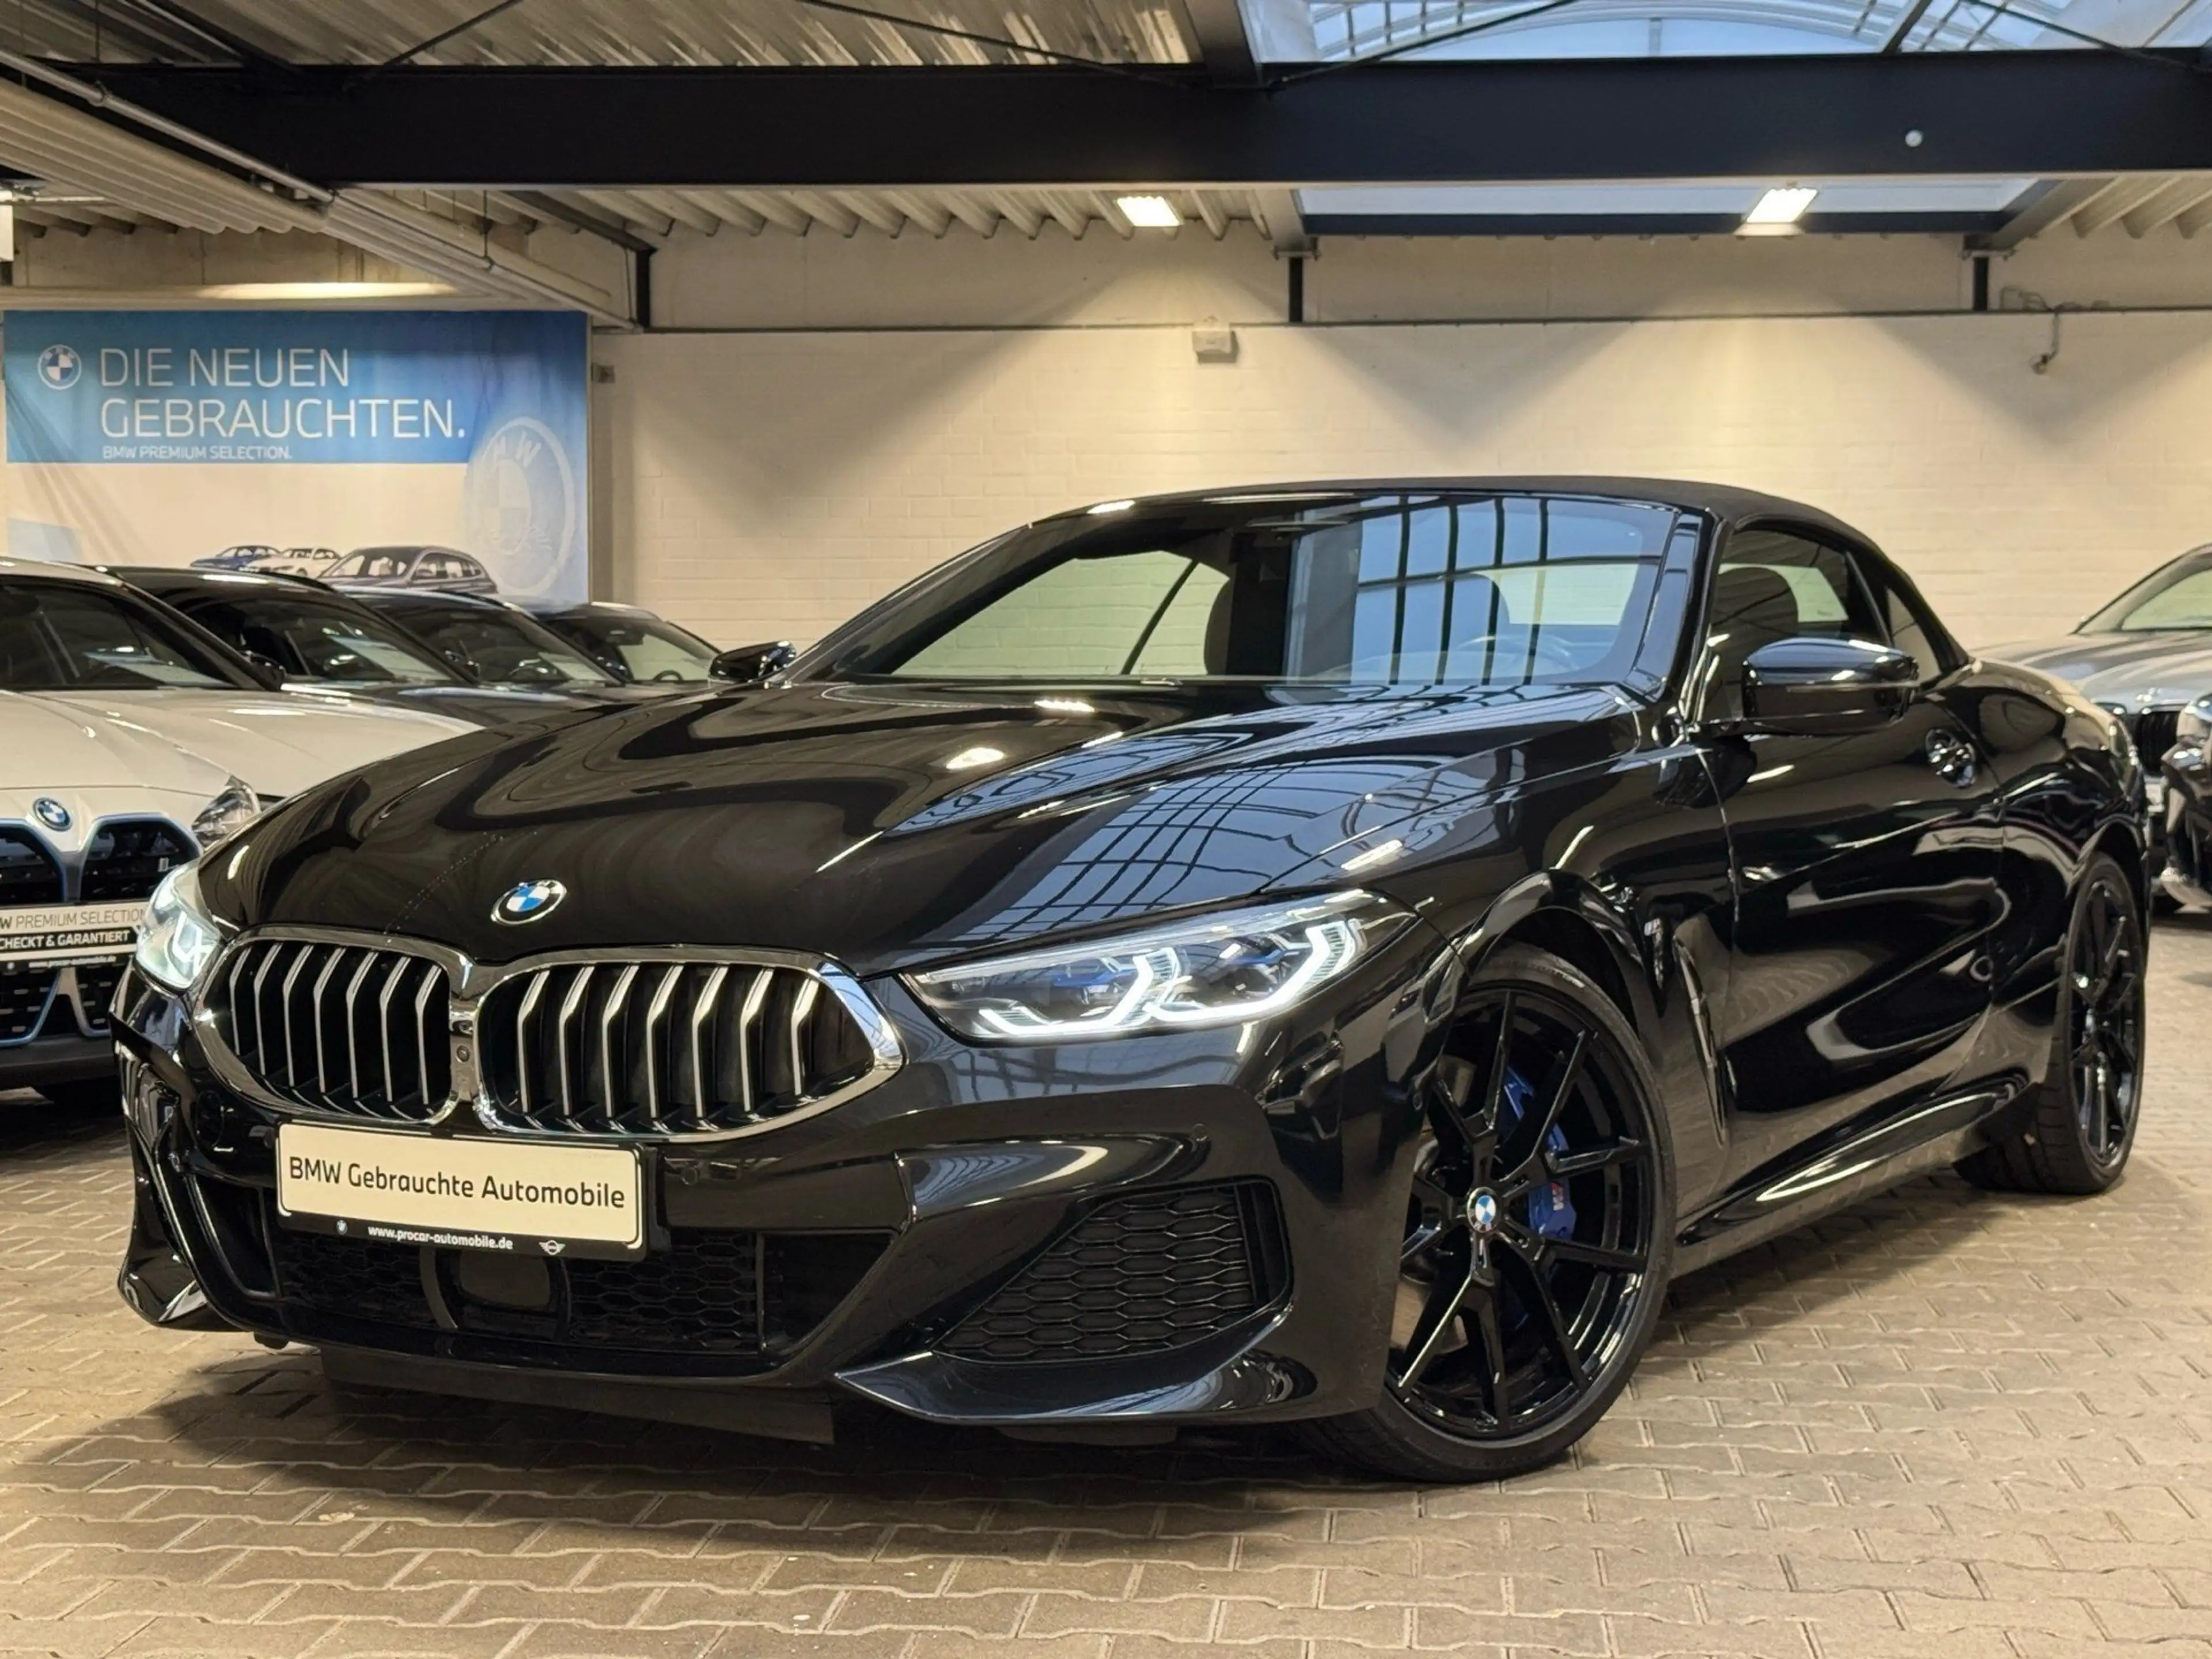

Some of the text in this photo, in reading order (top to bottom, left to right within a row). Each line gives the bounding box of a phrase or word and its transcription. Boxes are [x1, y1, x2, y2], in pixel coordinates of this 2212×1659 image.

[100, 348, 349, 388] DIE NEUEN
[101, 397, 465, 438] GEBRAUCHTEN.
[103, 445, 293, 460] BMW PREMIUM SELECTION.
[16, 912, 77, 928] PREMIUM
[46, 934, 55, 947] &
[58, 930, 130, 946] GARANTIERT
[289, 1156, 625, 1208] BMW Gebrauchte Automobile
[368, 1226, 514, 1250] www.procar-automobile.de
